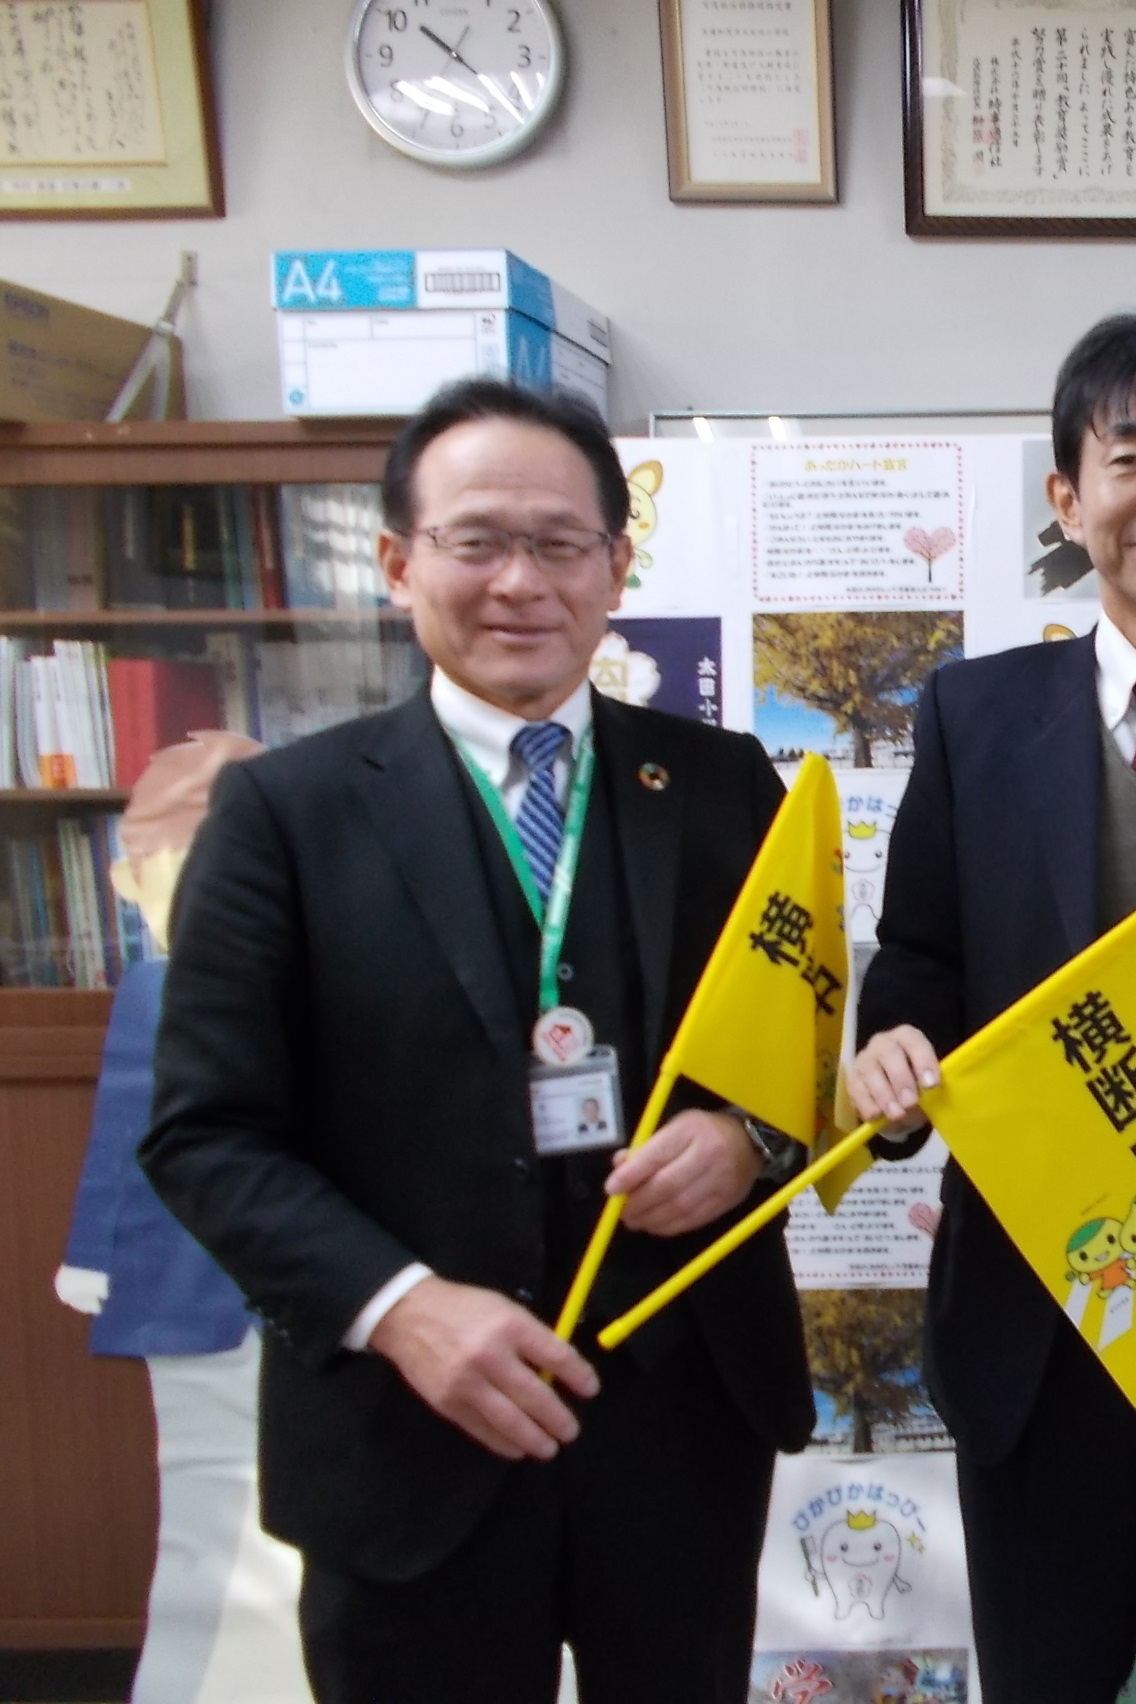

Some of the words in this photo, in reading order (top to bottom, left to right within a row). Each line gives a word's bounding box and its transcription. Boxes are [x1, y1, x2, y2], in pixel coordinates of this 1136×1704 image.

[387, 10, 408, 32] 10
[507, 10, 521, 33] 2
[379, 44, 394, 67] 9
[517, 45, 531, 68] 3
[281, 257, 344, 303] A4
